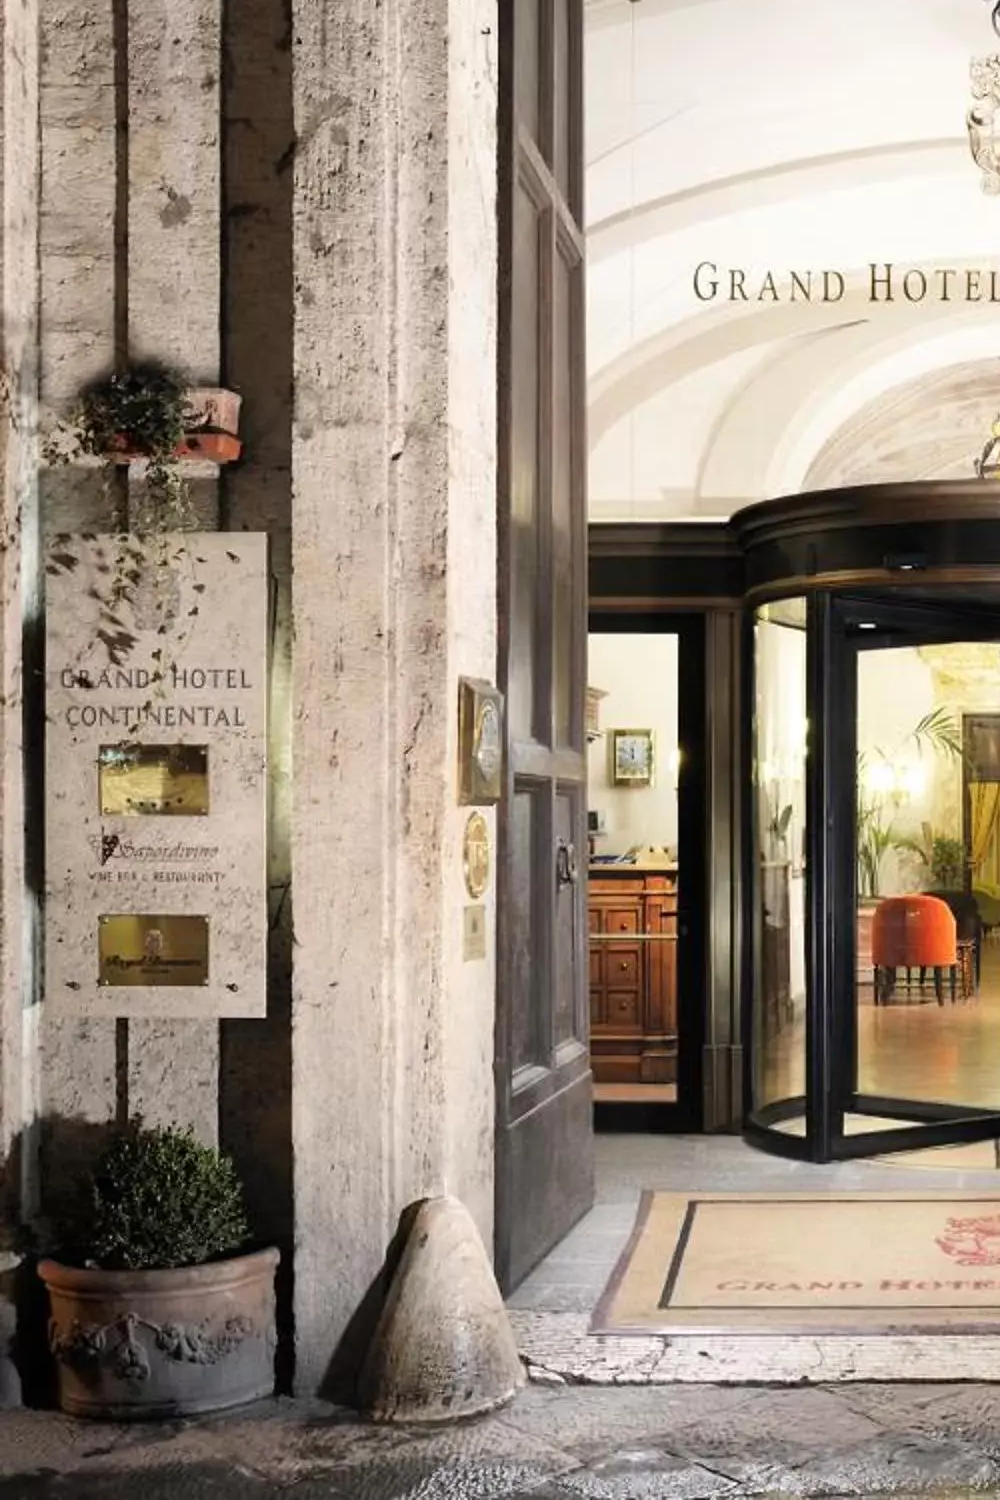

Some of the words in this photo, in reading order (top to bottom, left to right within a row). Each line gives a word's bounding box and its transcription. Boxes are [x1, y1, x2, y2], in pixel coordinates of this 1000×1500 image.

[693, 261, 846, 303] GRAND
[60, 668, 150, 689] GRAND
[172, 668, 252, 689] HOTEL
[65, 705, 246, 727] CONTINENTAL
[716, 1279, 864, 1291] GRAND
